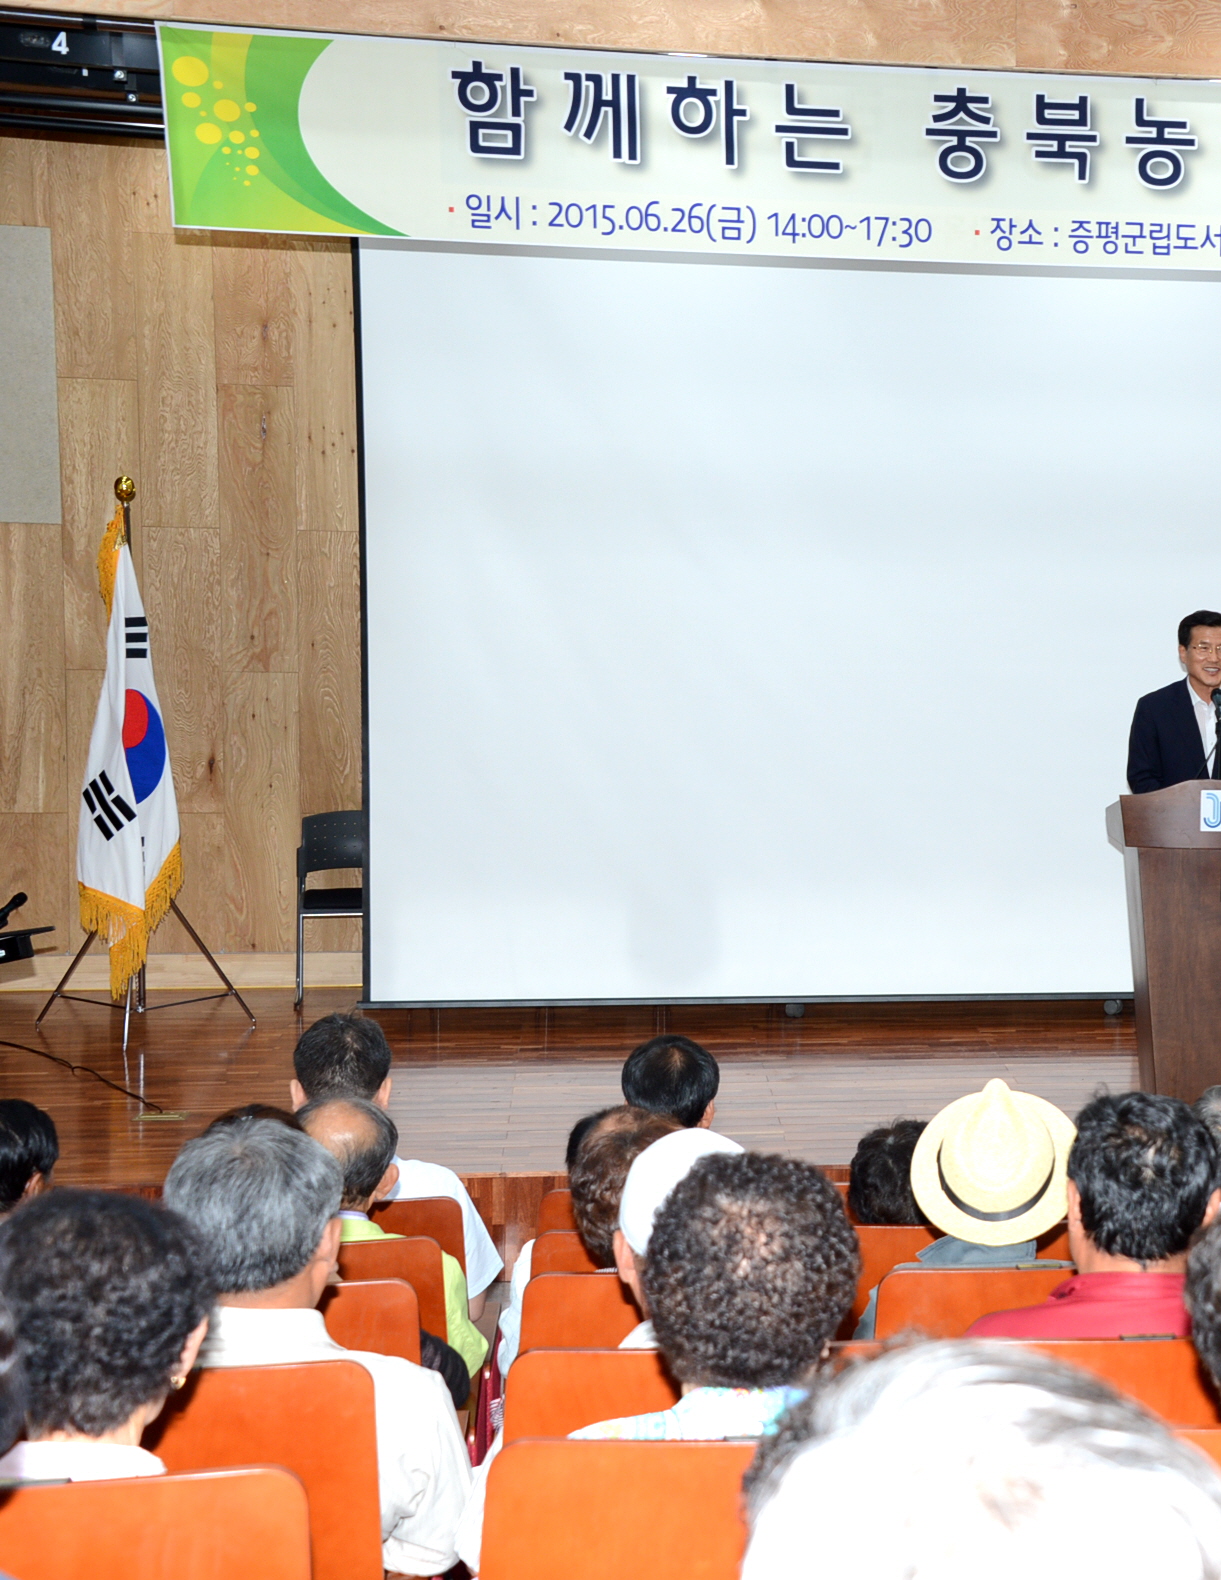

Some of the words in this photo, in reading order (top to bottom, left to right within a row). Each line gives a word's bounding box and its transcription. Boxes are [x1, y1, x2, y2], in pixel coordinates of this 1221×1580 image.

[51, 31, 70, 55] 4
[452, 61, 850, 171] 함께하는
[548, 201, 757, 244] 2015.06.26(금)
[767, 212, 933, 248] 14:00~17:30
